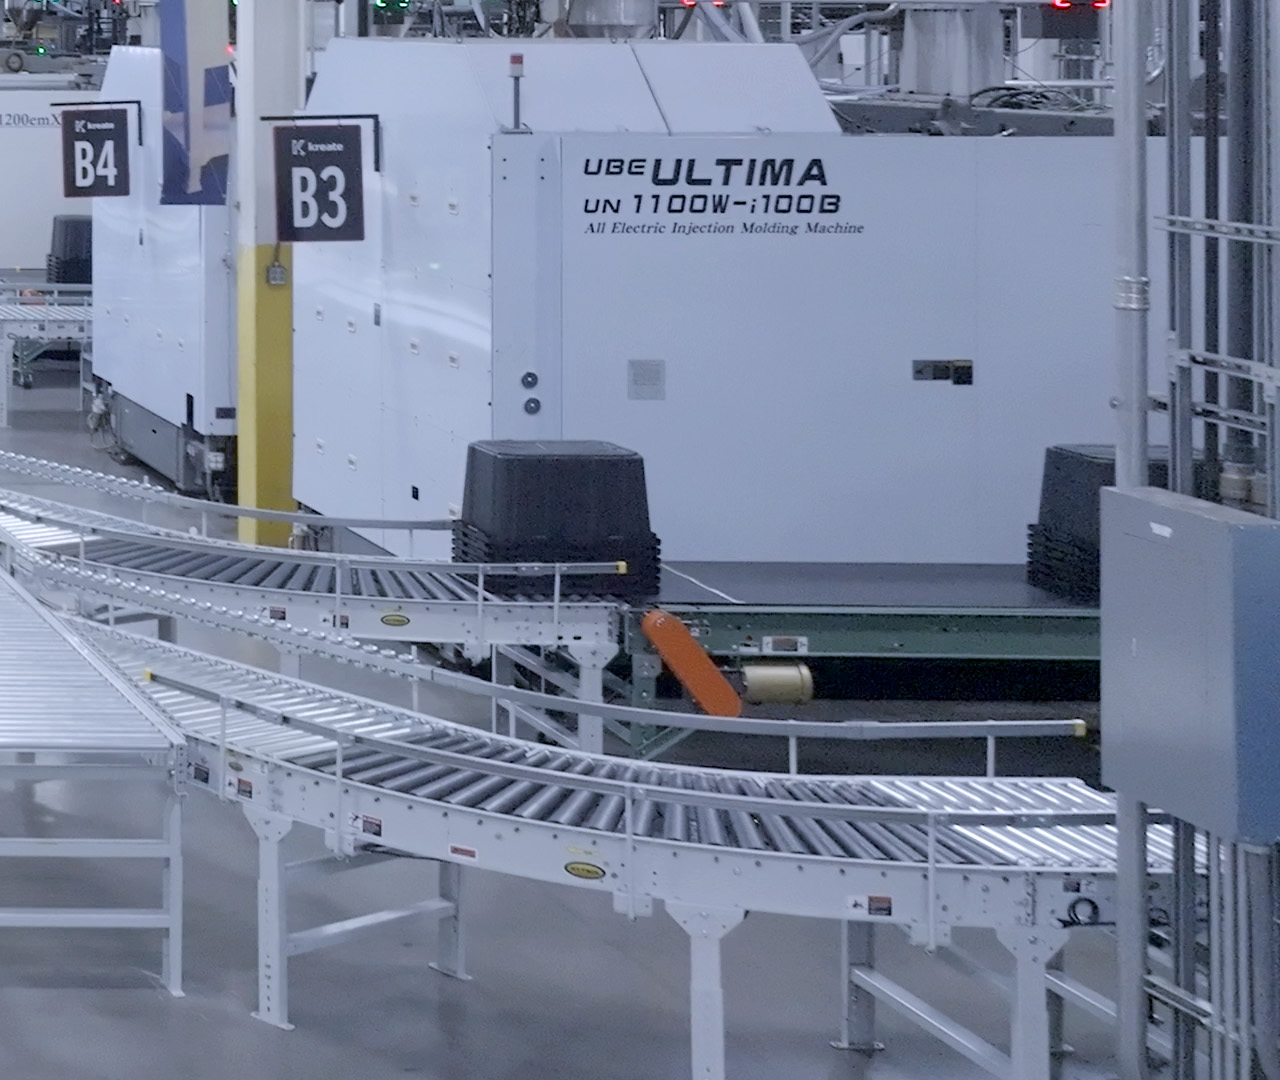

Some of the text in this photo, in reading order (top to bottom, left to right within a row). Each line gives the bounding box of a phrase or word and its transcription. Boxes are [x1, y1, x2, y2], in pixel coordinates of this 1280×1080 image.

[307, 142, 344, 152] kreate
[74, 139, 118, 188] B4
[583, 158, 828, 186] UBE ULTIMA
[291, 165, 347, 229] B3
[583, 194, 842, 214] UN 1100W-i100B
[583, 221, 865, 236] All Electric Injection Molding Machine
